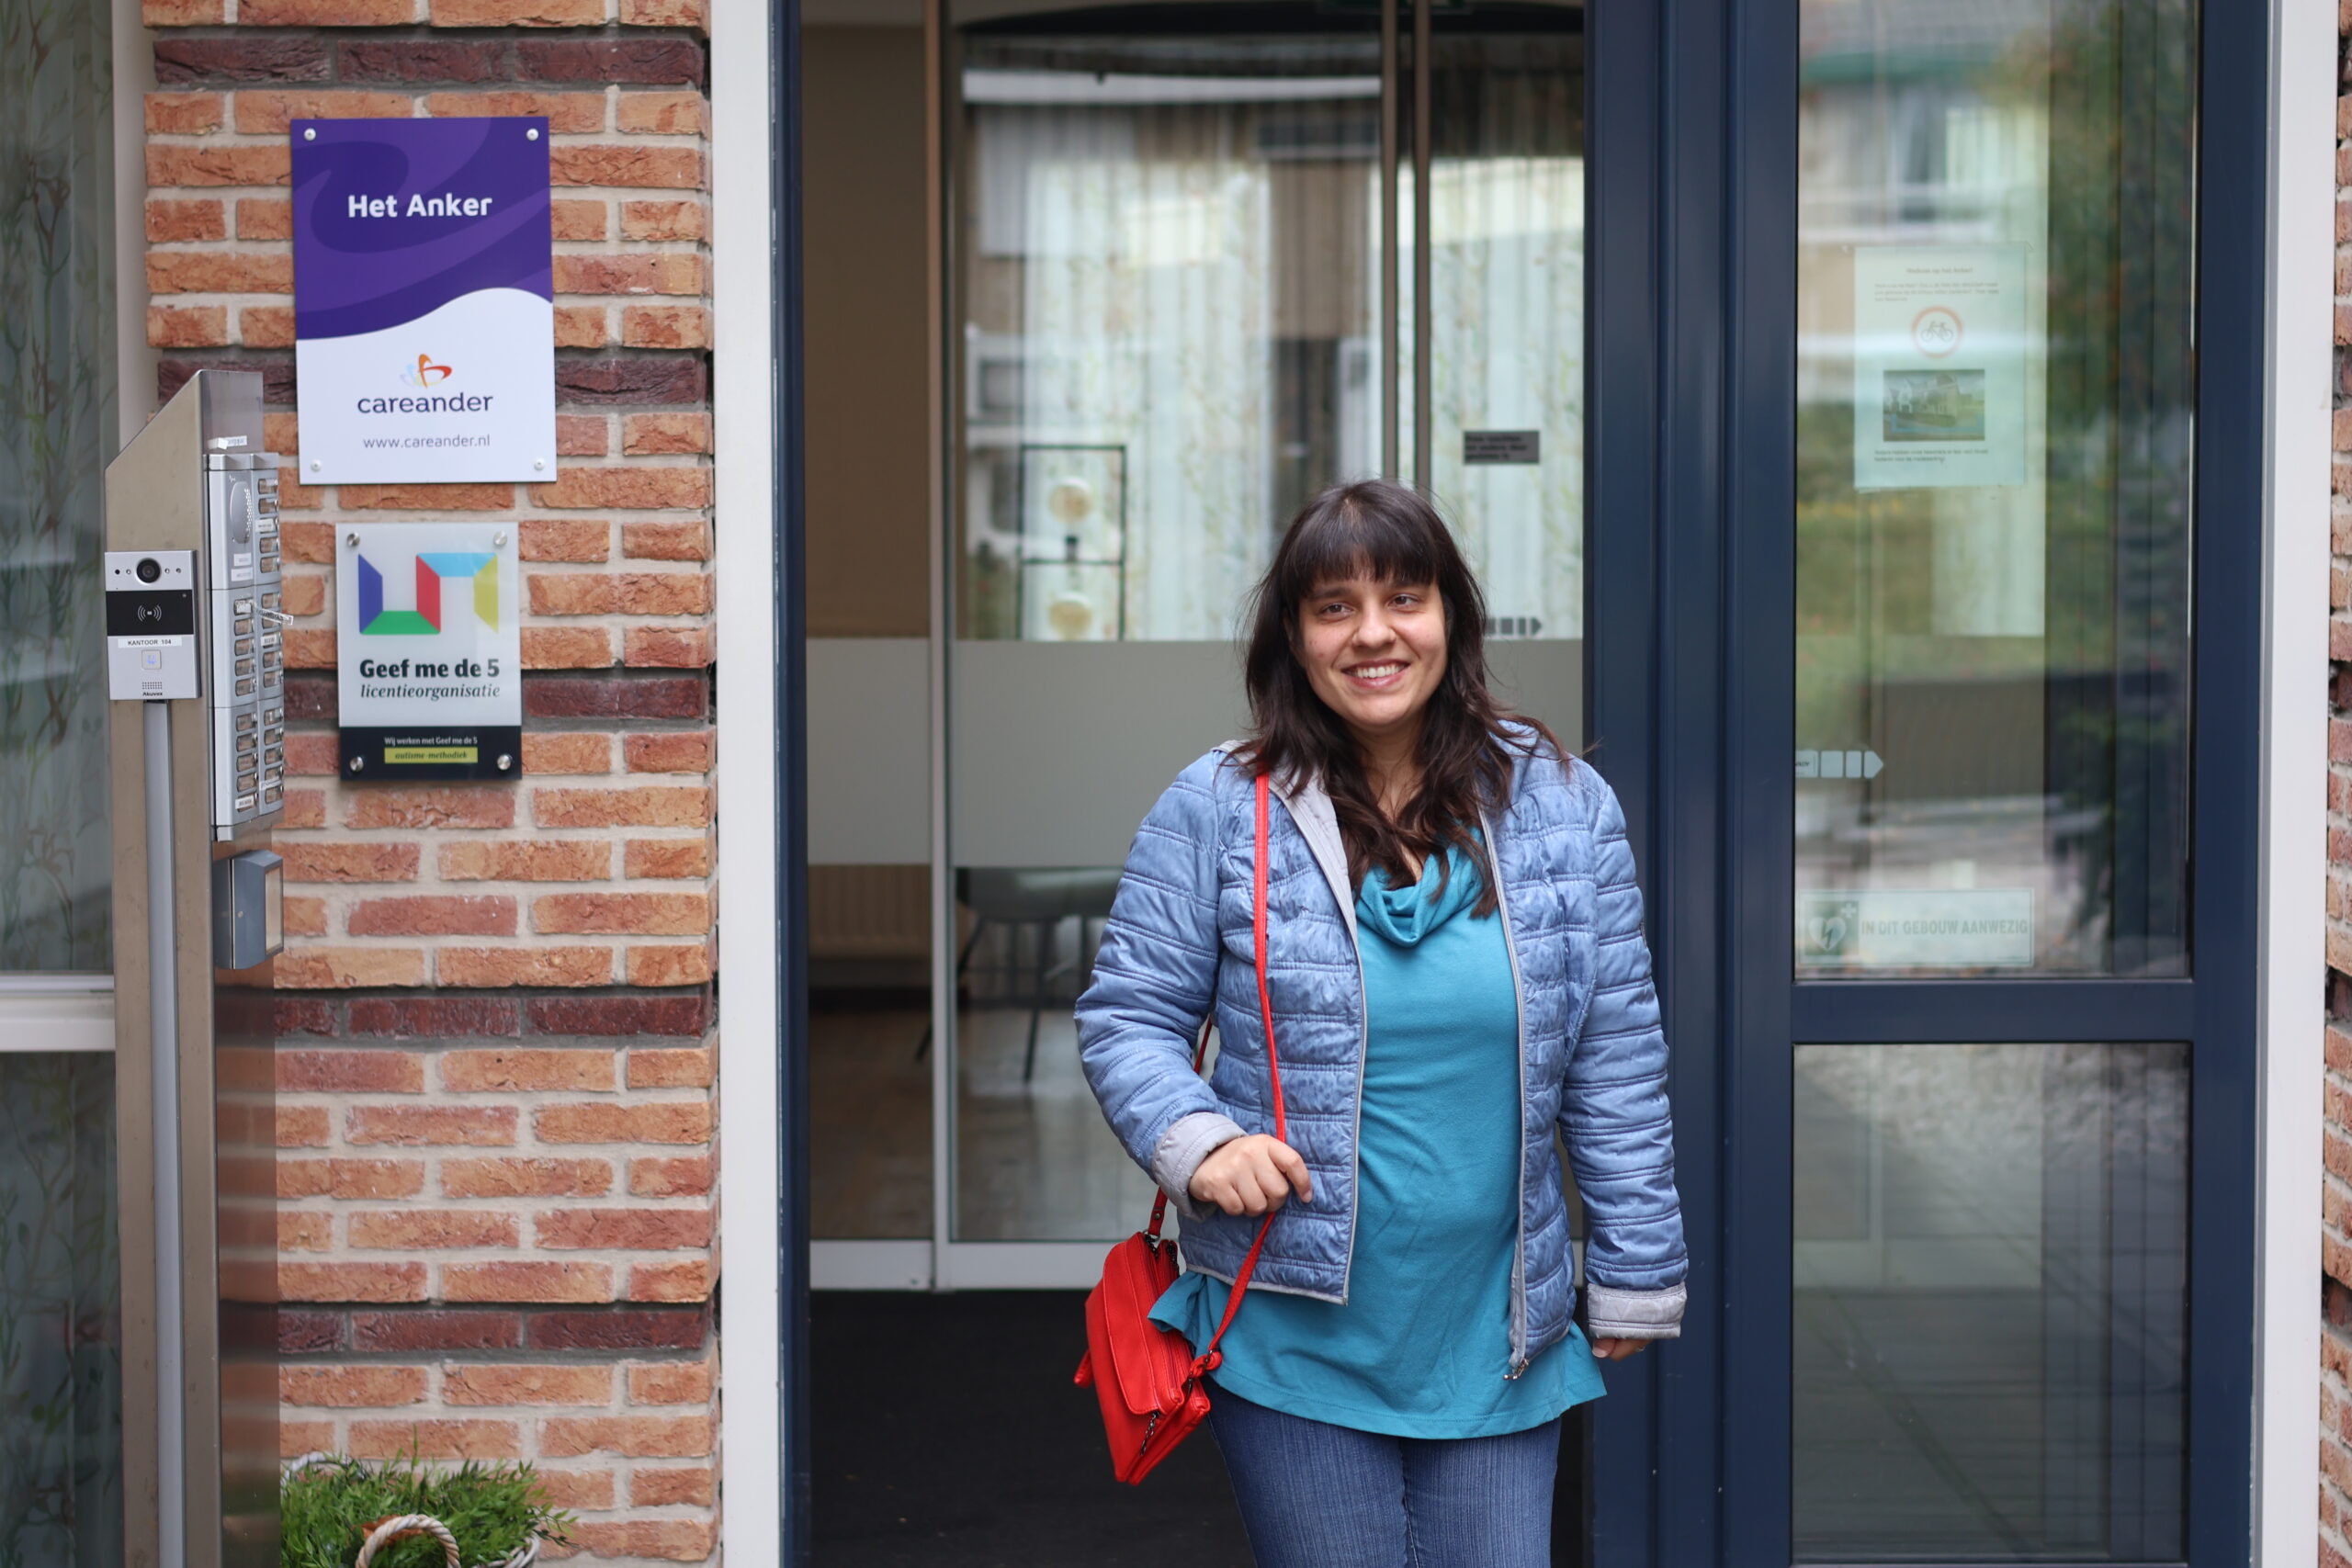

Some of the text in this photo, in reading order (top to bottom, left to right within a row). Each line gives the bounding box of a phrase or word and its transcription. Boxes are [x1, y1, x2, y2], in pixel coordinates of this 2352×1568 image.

[347, 193, 493, 218] Het Anker
[356, 392, 493, 413] careander
[363, 434, 491, 449] www.careander.nl
[359, 659, 500, 678] Geef me de 5
[360, 683, 501, 701] licentieorganisatie
[384, 737, 396, 747] Wij
[397, 737, 421, 745] werken
[422, 737, 435, 745] met
[435, 736, 451, 745] Geef
[464, 736, 472, 745] de
[1861, 919, 2029, 935] IN DIT GEBOUW AANWEZIG
